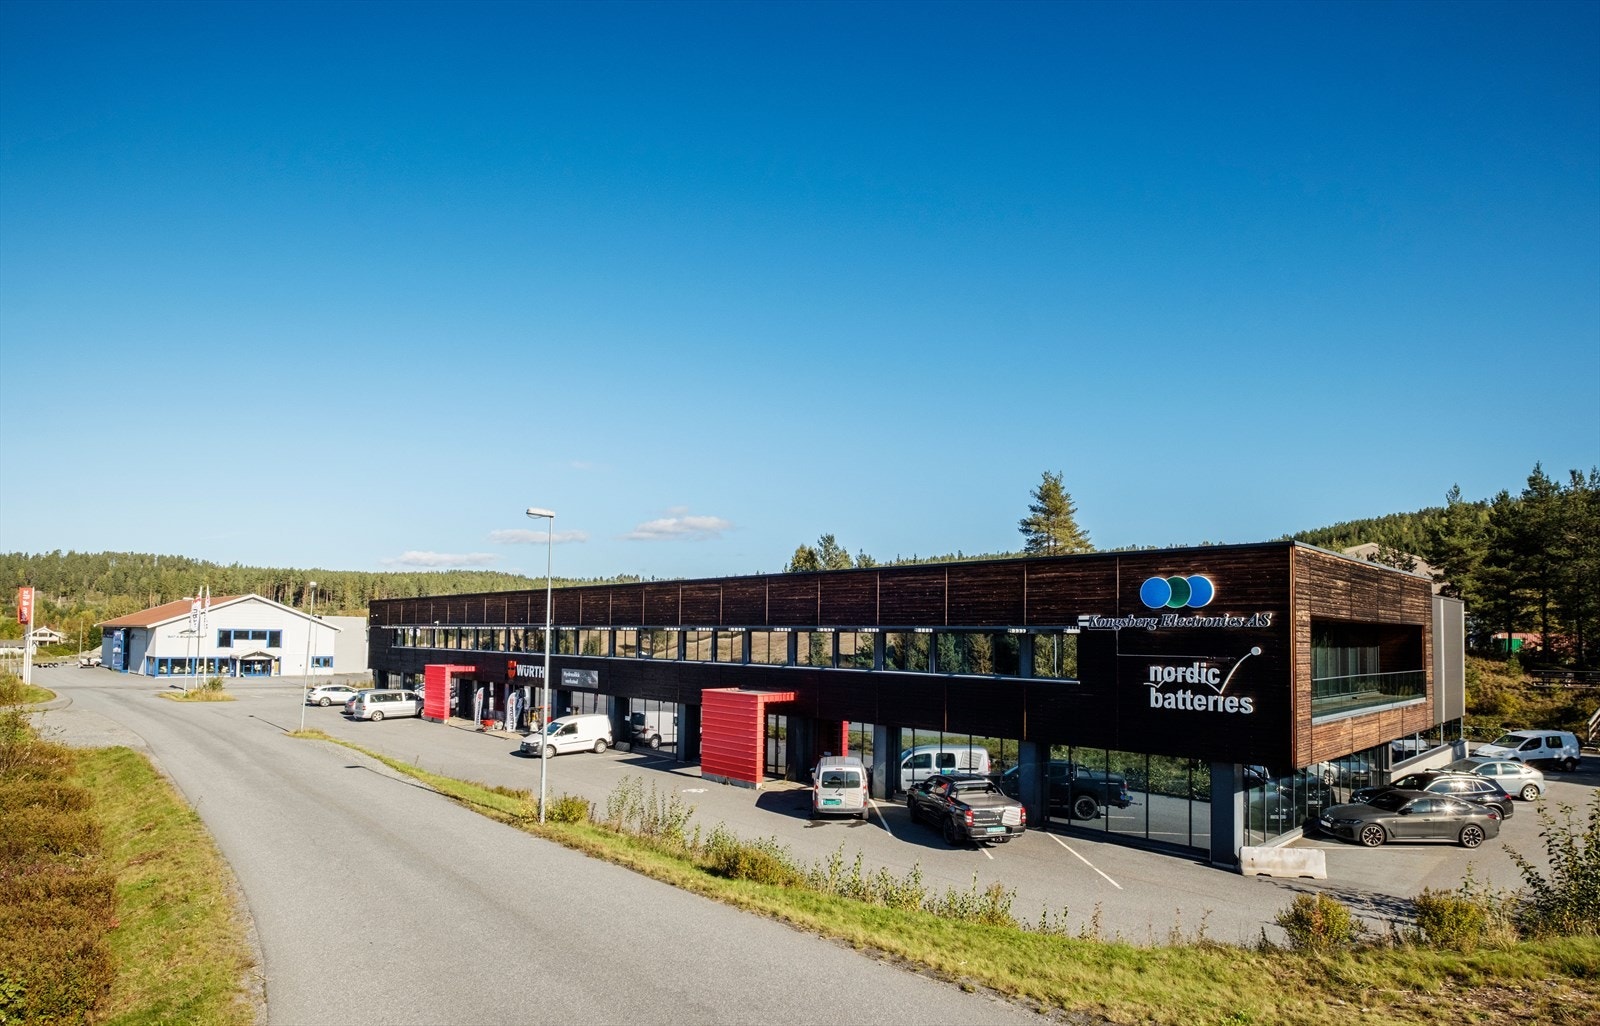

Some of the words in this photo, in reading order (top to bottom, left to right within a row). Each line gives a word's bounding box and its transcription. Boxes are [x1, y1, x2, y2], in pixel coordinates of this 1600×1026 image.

[1088, 614, 1158, 631] Kongsberg
[1159, 613, 1244, 628] Electronics
[1244, 612, 1272, 628] AS
[516, 664, 545, 679] WÜRTH
[1150, 687, 1254, 714] batteries
